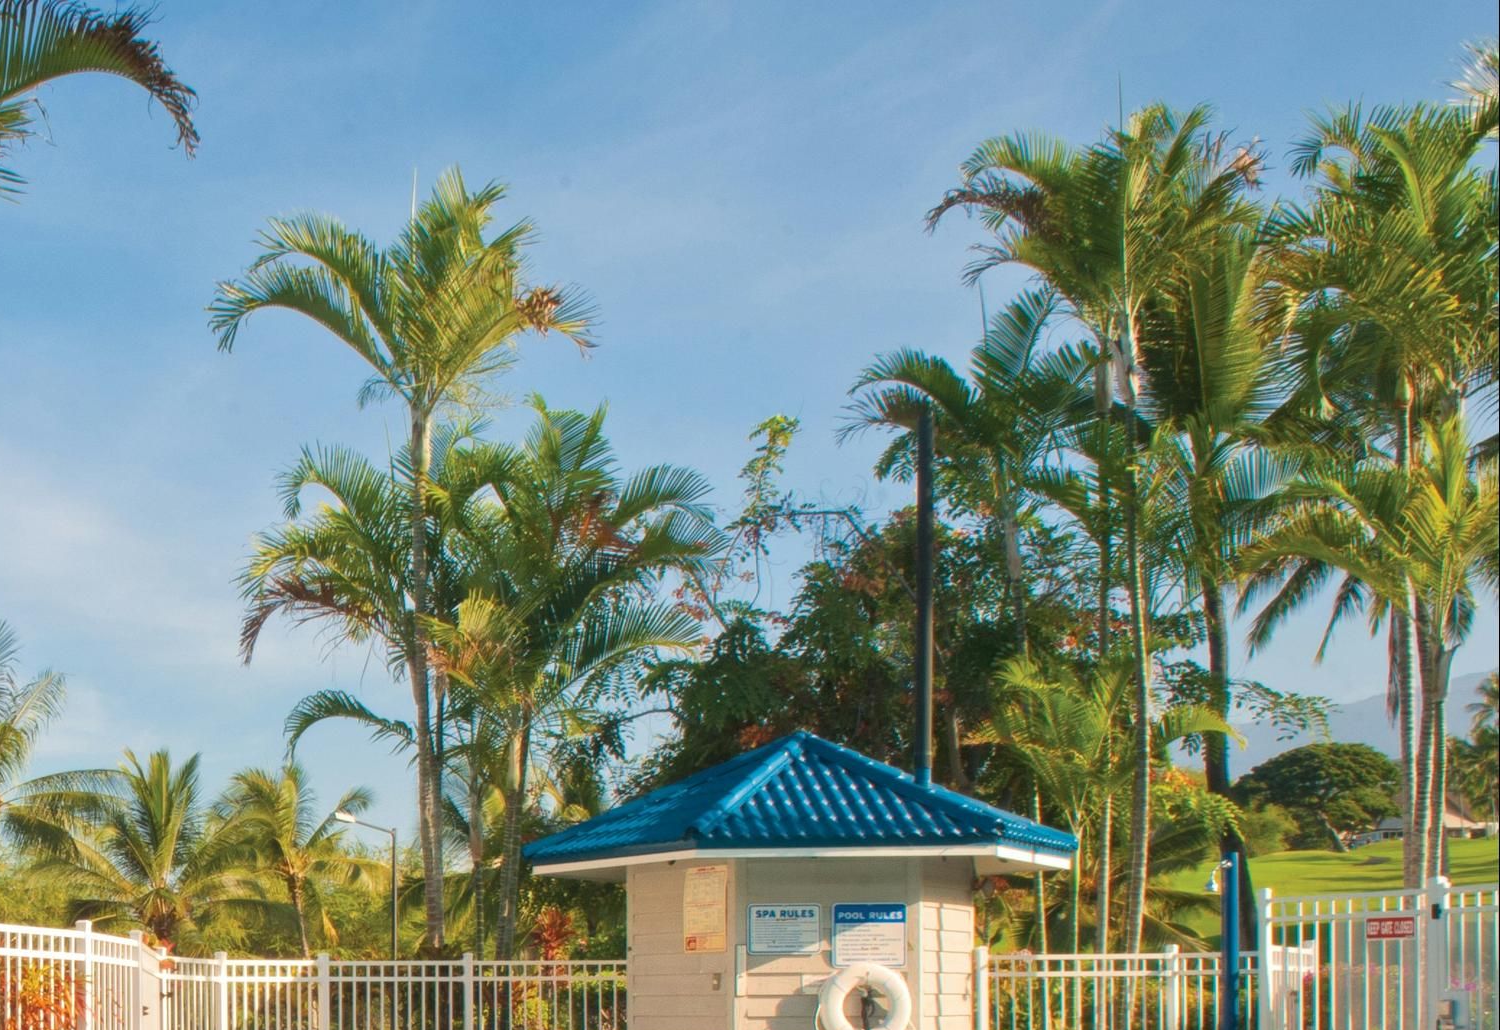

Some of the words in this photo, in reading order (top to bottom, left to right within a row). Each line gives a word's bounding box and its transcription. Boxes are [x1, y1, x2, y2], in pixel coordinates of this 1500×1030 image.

[755, 910, 776, 918] SPA
[780, 909, 815, 918] RULES
[838, 911, 866, 920] POOL
[868, 911, 903, 920] RULES
